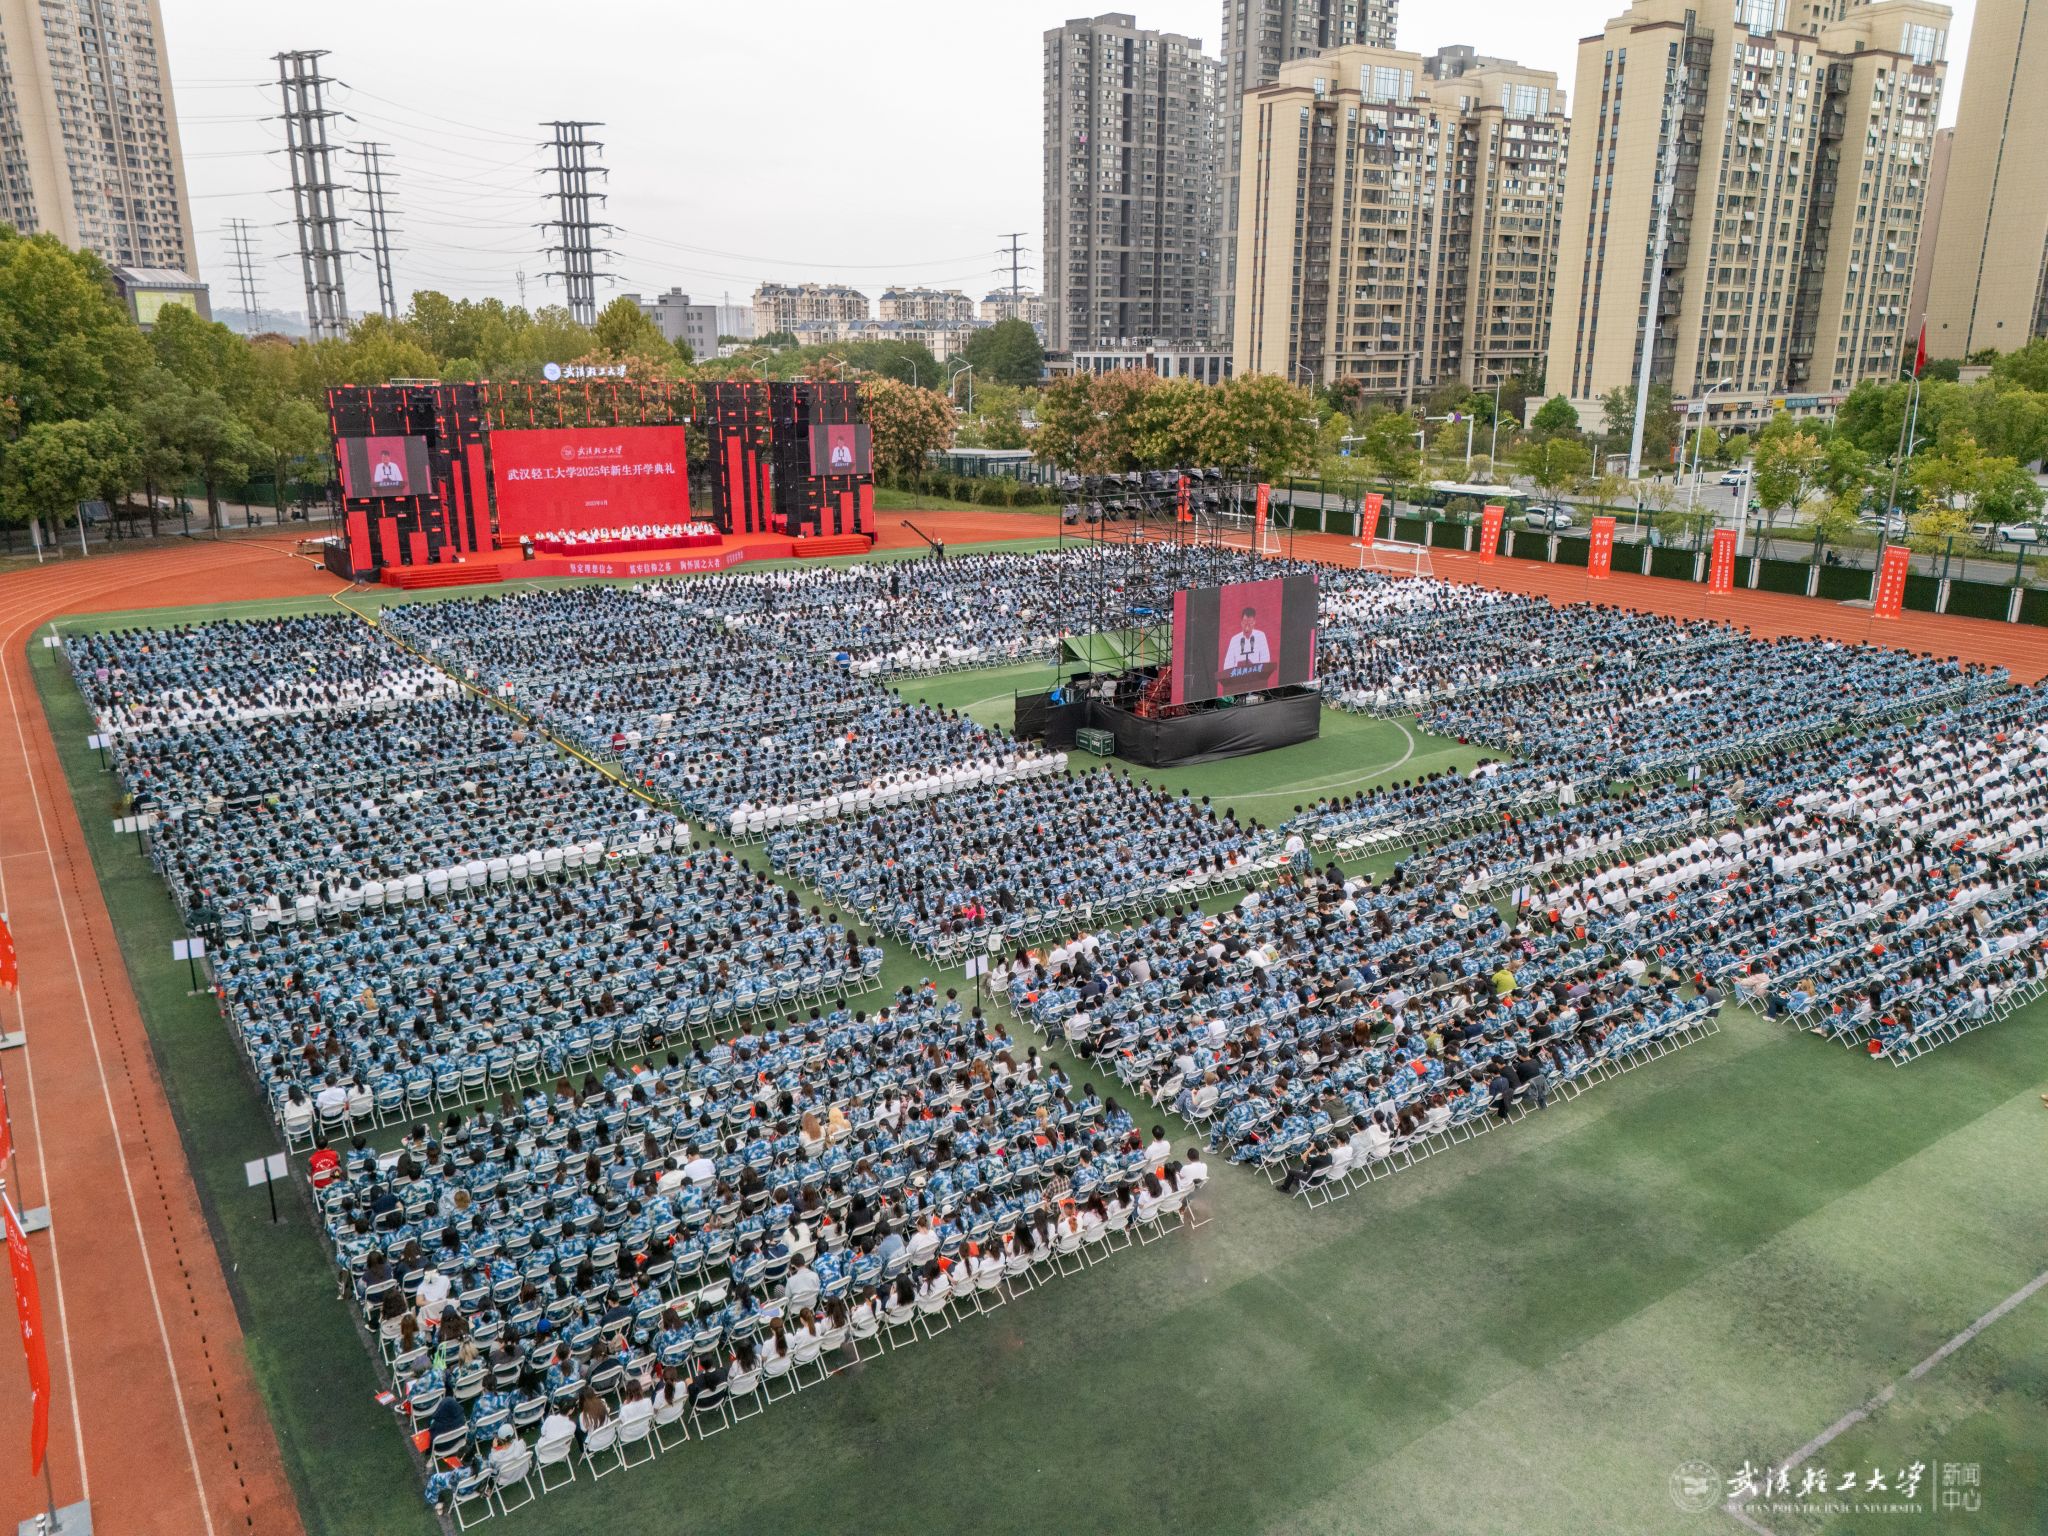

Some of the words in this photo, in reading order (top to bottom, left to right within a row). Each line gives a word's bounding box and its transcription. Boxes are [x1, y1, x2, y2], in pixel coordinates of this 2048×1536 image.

[508, 462, 675, 481] 武汉轻工大学2025年新生开学典礼
[569, 563, 613, 575] 坚定理想信念
[629, 562, 672, 574] 筑牢信仰之基
[680, 558, 720, 571] 胸怀国之大者
